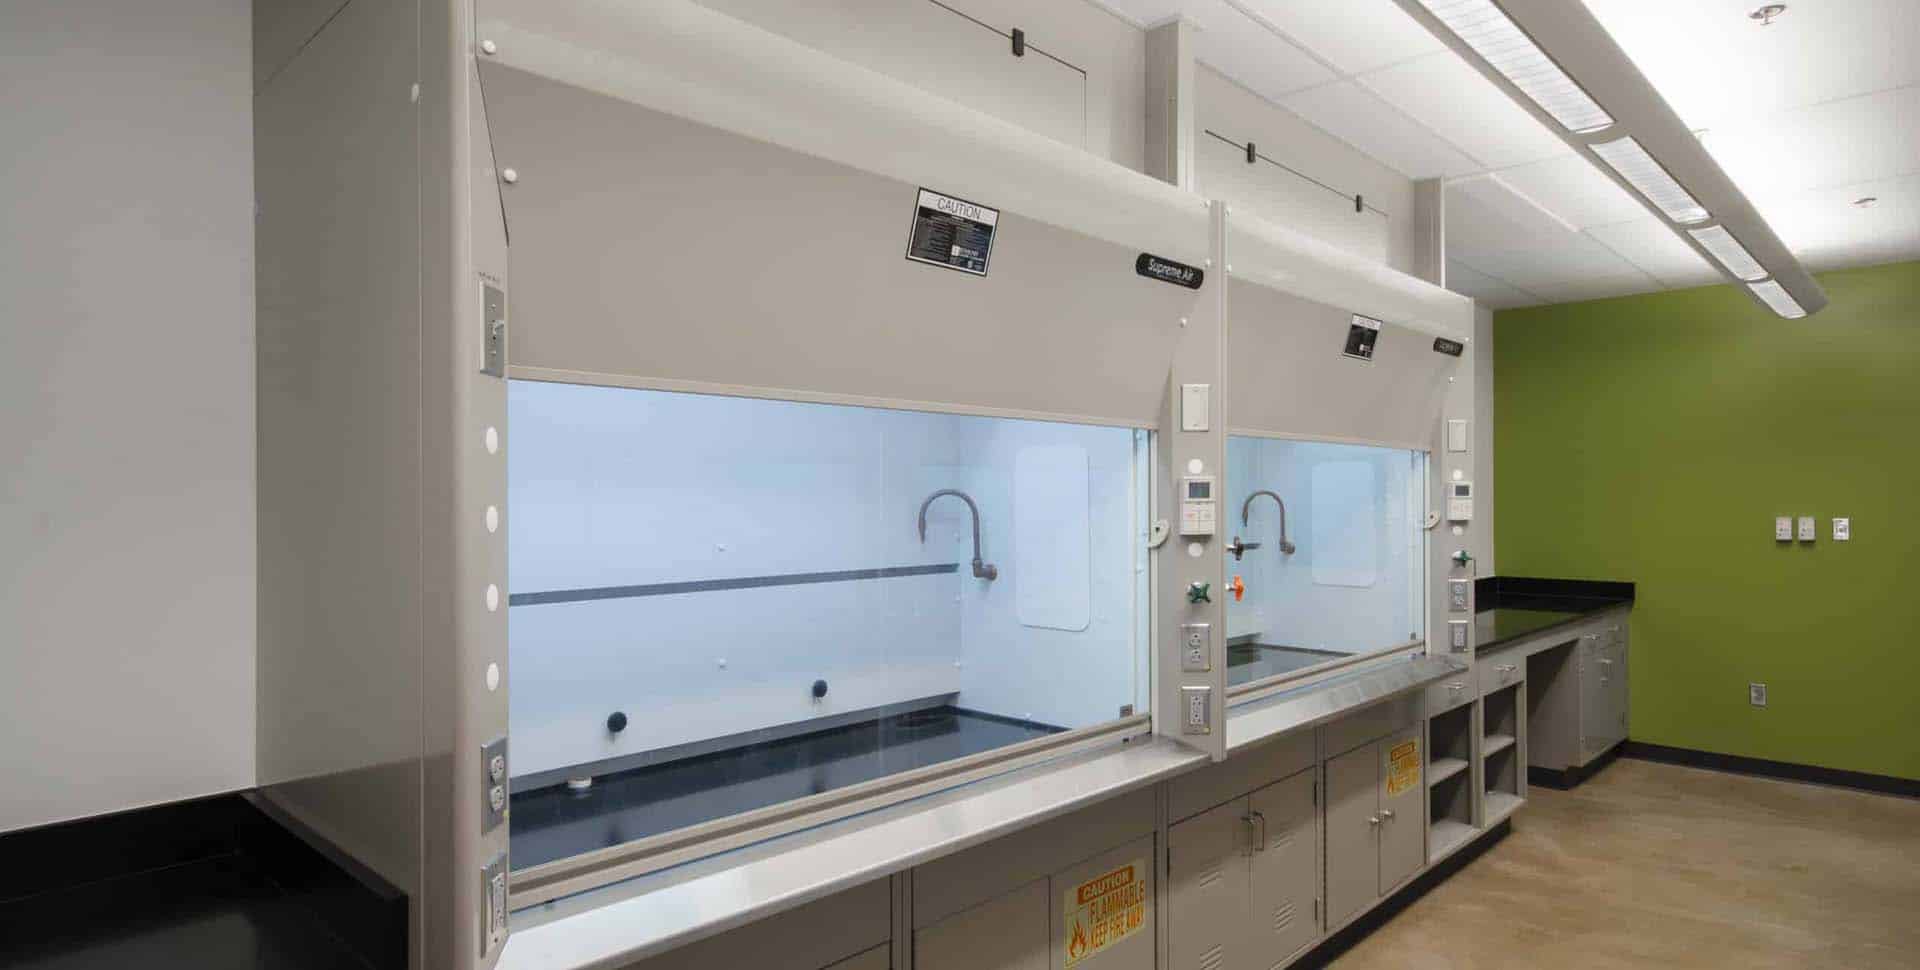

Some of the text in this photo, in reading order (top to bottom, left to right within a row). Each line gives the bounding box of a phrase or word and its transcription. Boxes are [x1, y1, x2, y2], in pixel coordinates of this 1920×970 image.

[937, 198, 981, 220] CAUTION
[1148, 258, 1182, 279] Supreme
[1182, 266, 1194, 281] Air
[1083, 870, 1129, 899] CAUTION
[1090, 880, 1144, 924] FLAMMABLE
[1090, 919, 1108, 950] KEEP
[1109, 911, 1125, 938] FIRE
